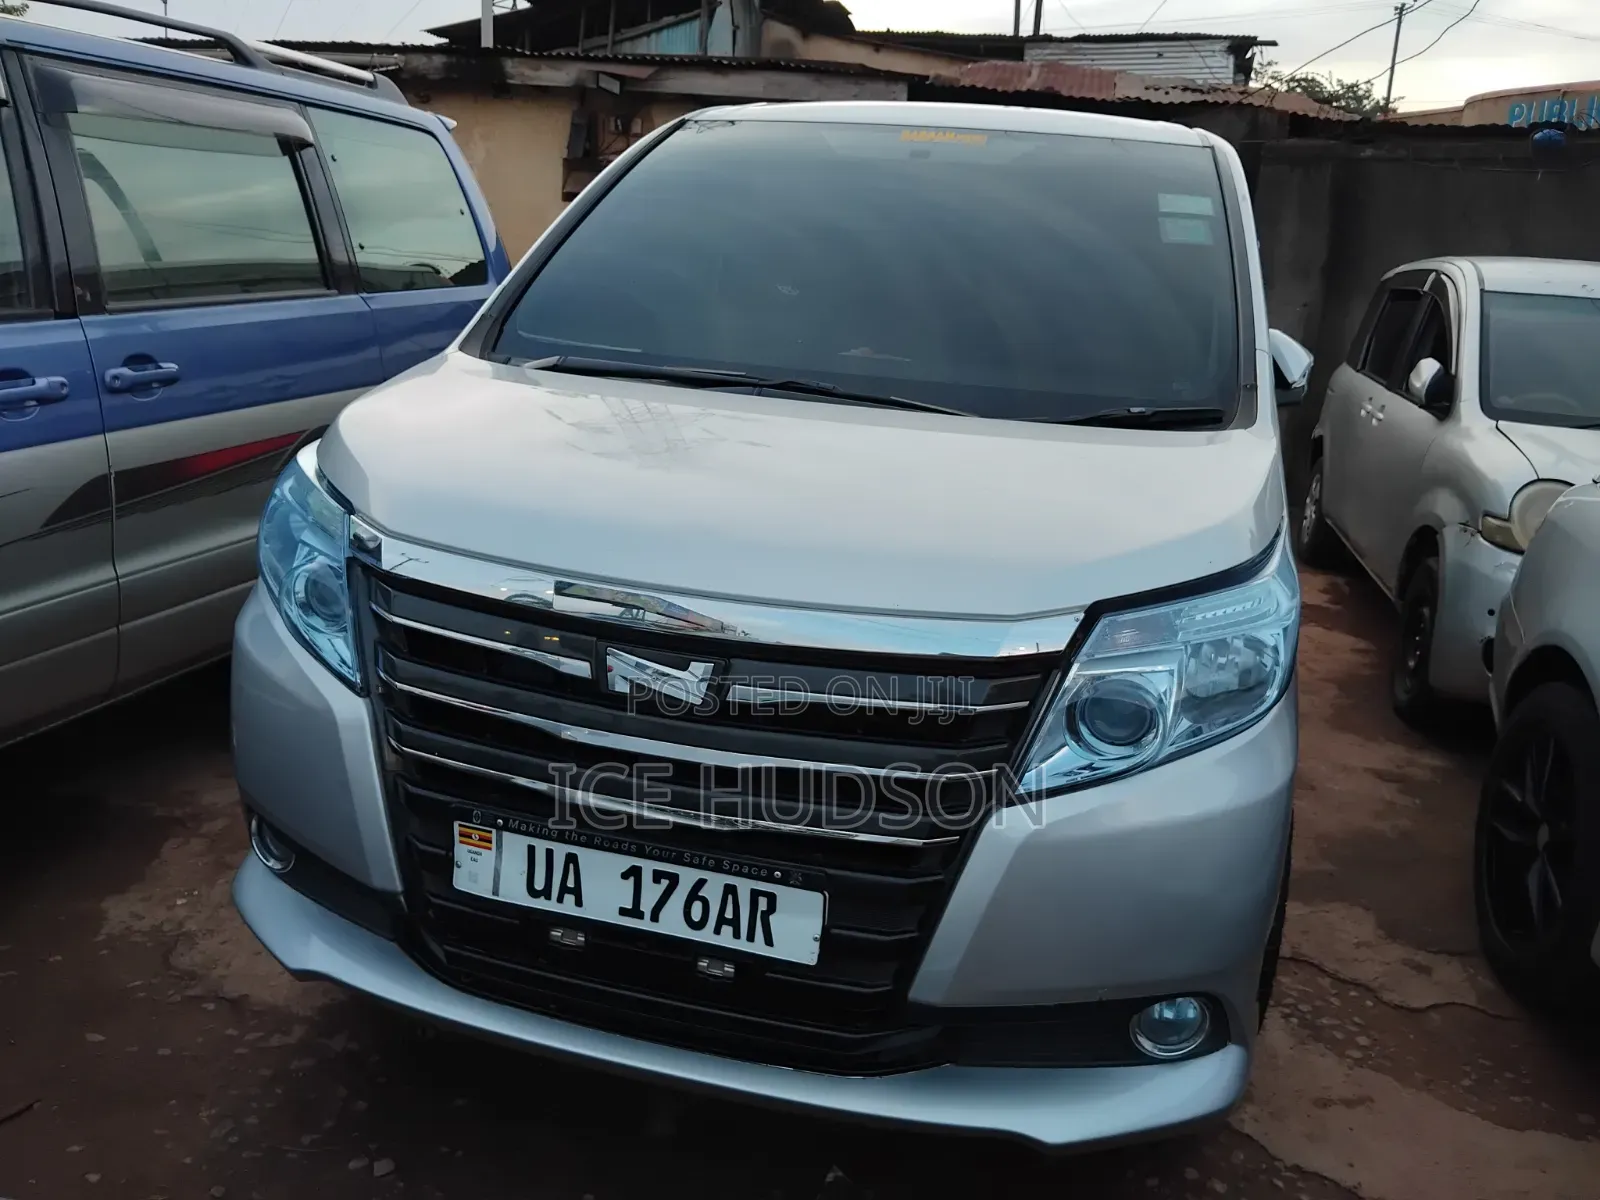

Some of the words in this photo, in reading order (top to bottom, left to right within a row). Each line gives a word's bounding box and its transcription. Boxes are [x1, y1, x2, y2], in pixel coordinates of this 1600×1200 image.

[1508, 96, 1600, 131] PUBLI
[508, 818, 558, 839] Making
[564, 827, 587, 843] the
[593, 836, 637, 853] Roads
[644, 844, 677, 860] Your
[683, 852, 716, 867] Safe
[722, 860, 768, 877] Space
[526, 843, 583, 908] UA
[618, 864, 777, 947] 176AR
